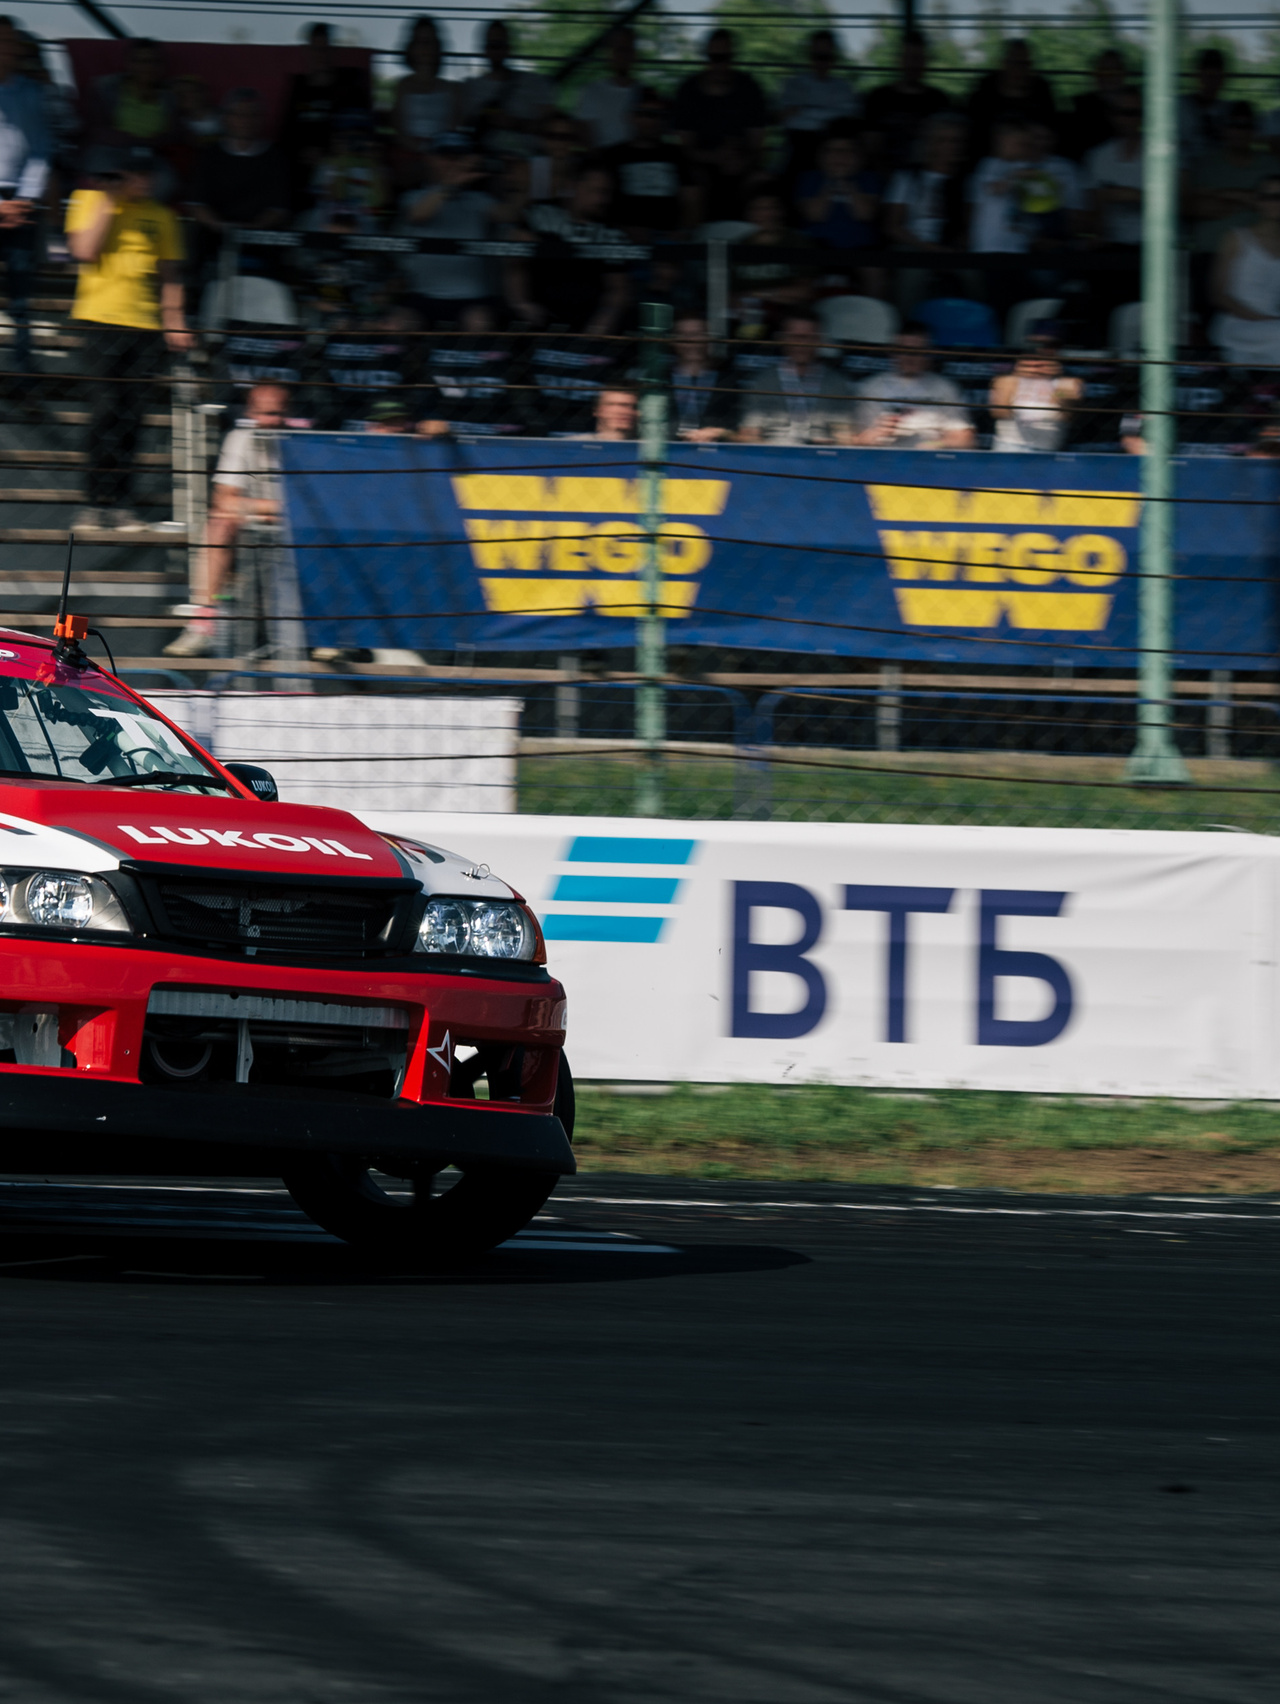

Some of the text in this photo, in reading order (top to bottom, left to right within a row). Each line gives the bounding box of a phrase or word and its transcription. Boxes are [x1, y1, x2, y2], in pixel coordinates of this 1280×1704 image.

[463, 518, 714, 575] WEGO
[877, 529, 1128, 587] WEGO
[117, 824, 374, 862] LUKOIL
[725, 878, 1080, 1048] ВТБ
